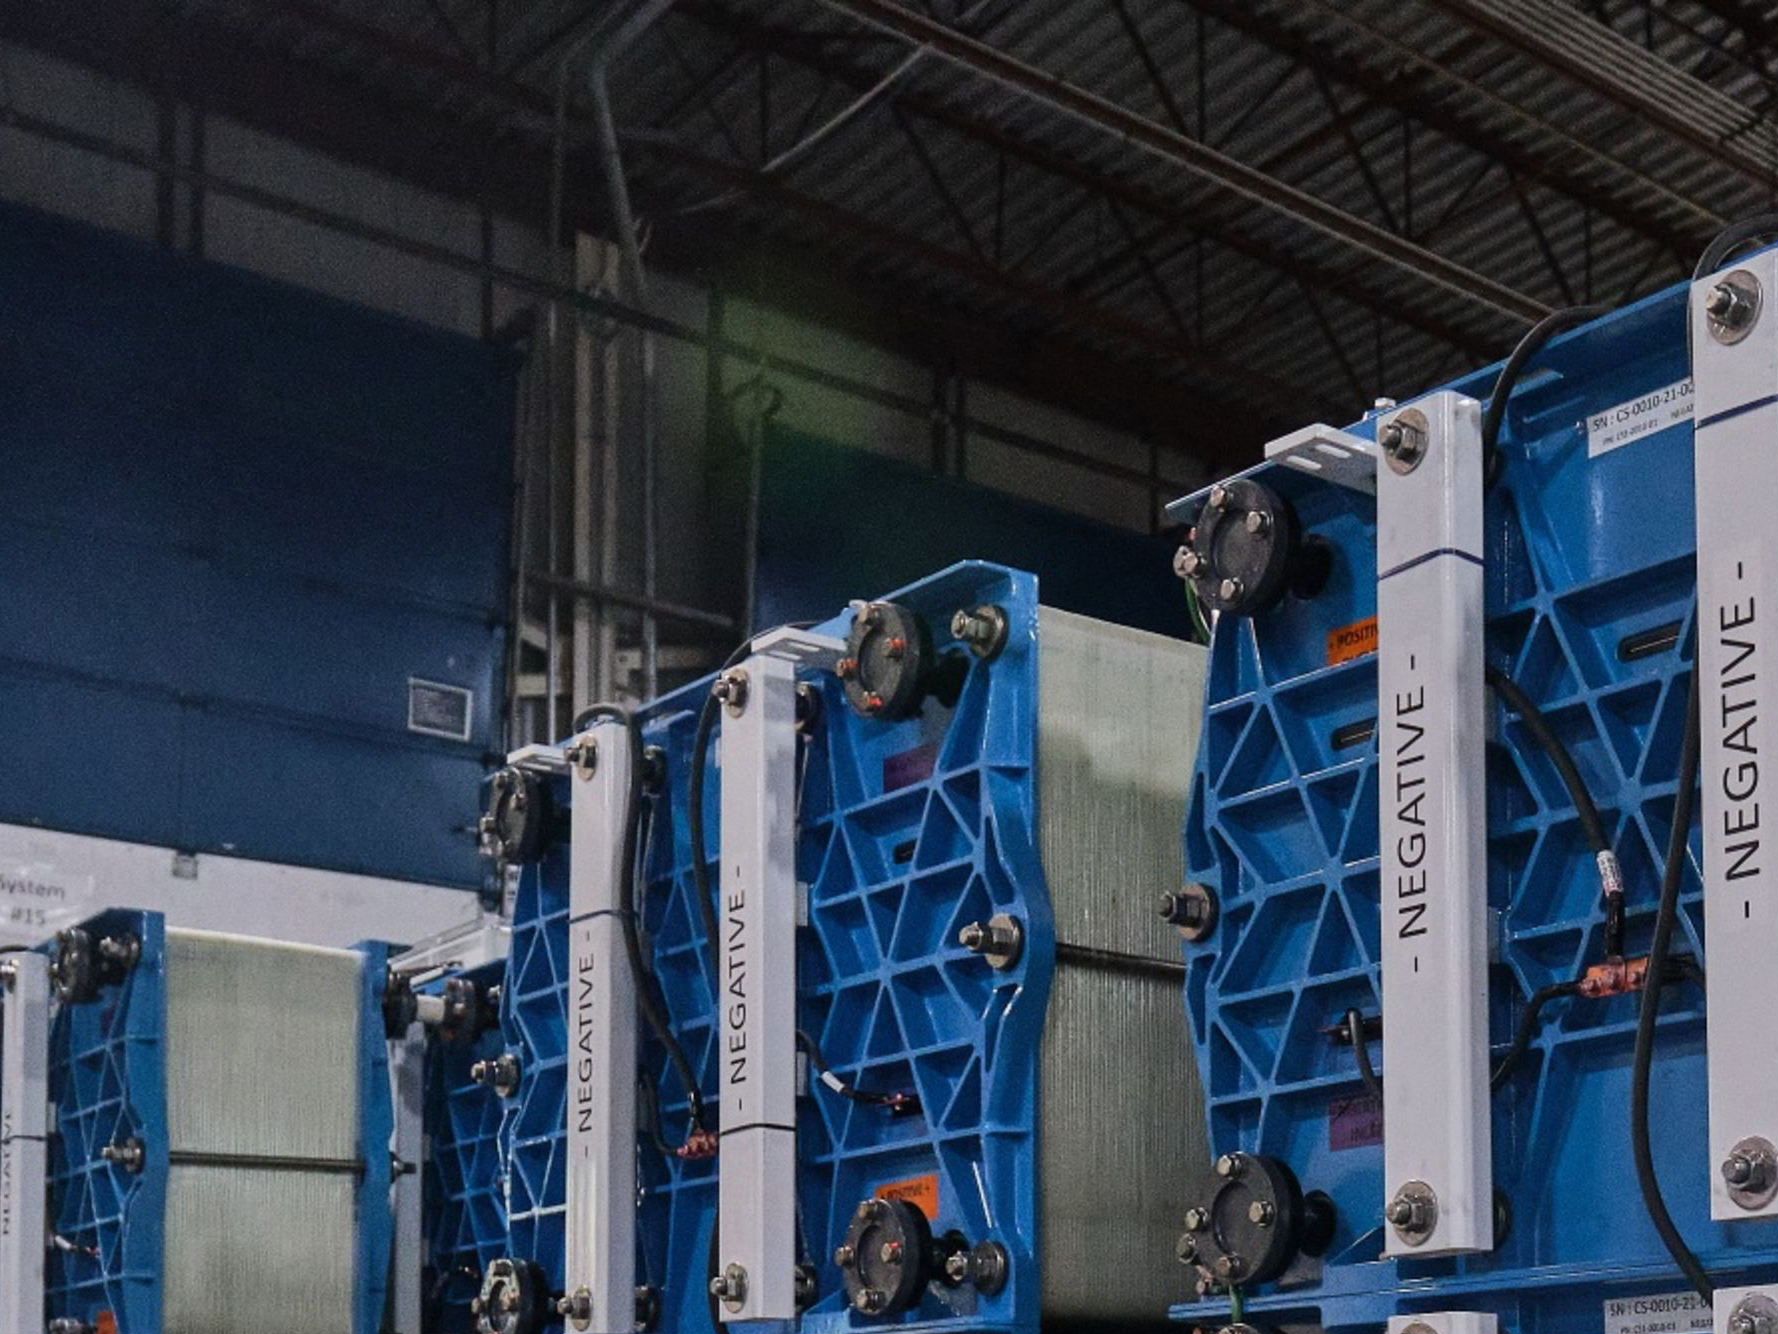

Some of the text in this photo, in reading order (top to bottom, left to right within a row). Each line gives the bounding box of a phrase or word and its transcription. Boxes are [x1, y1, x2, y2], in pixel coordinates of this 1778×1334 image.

[1395, 685, 1428, 940] NEGATIVE
[1719, 596, 1761, 882] NEGATIVE
[577, 953, 594, 1133] NEGATIVE
[728, 890, 747, 1085] NEGATIVE
